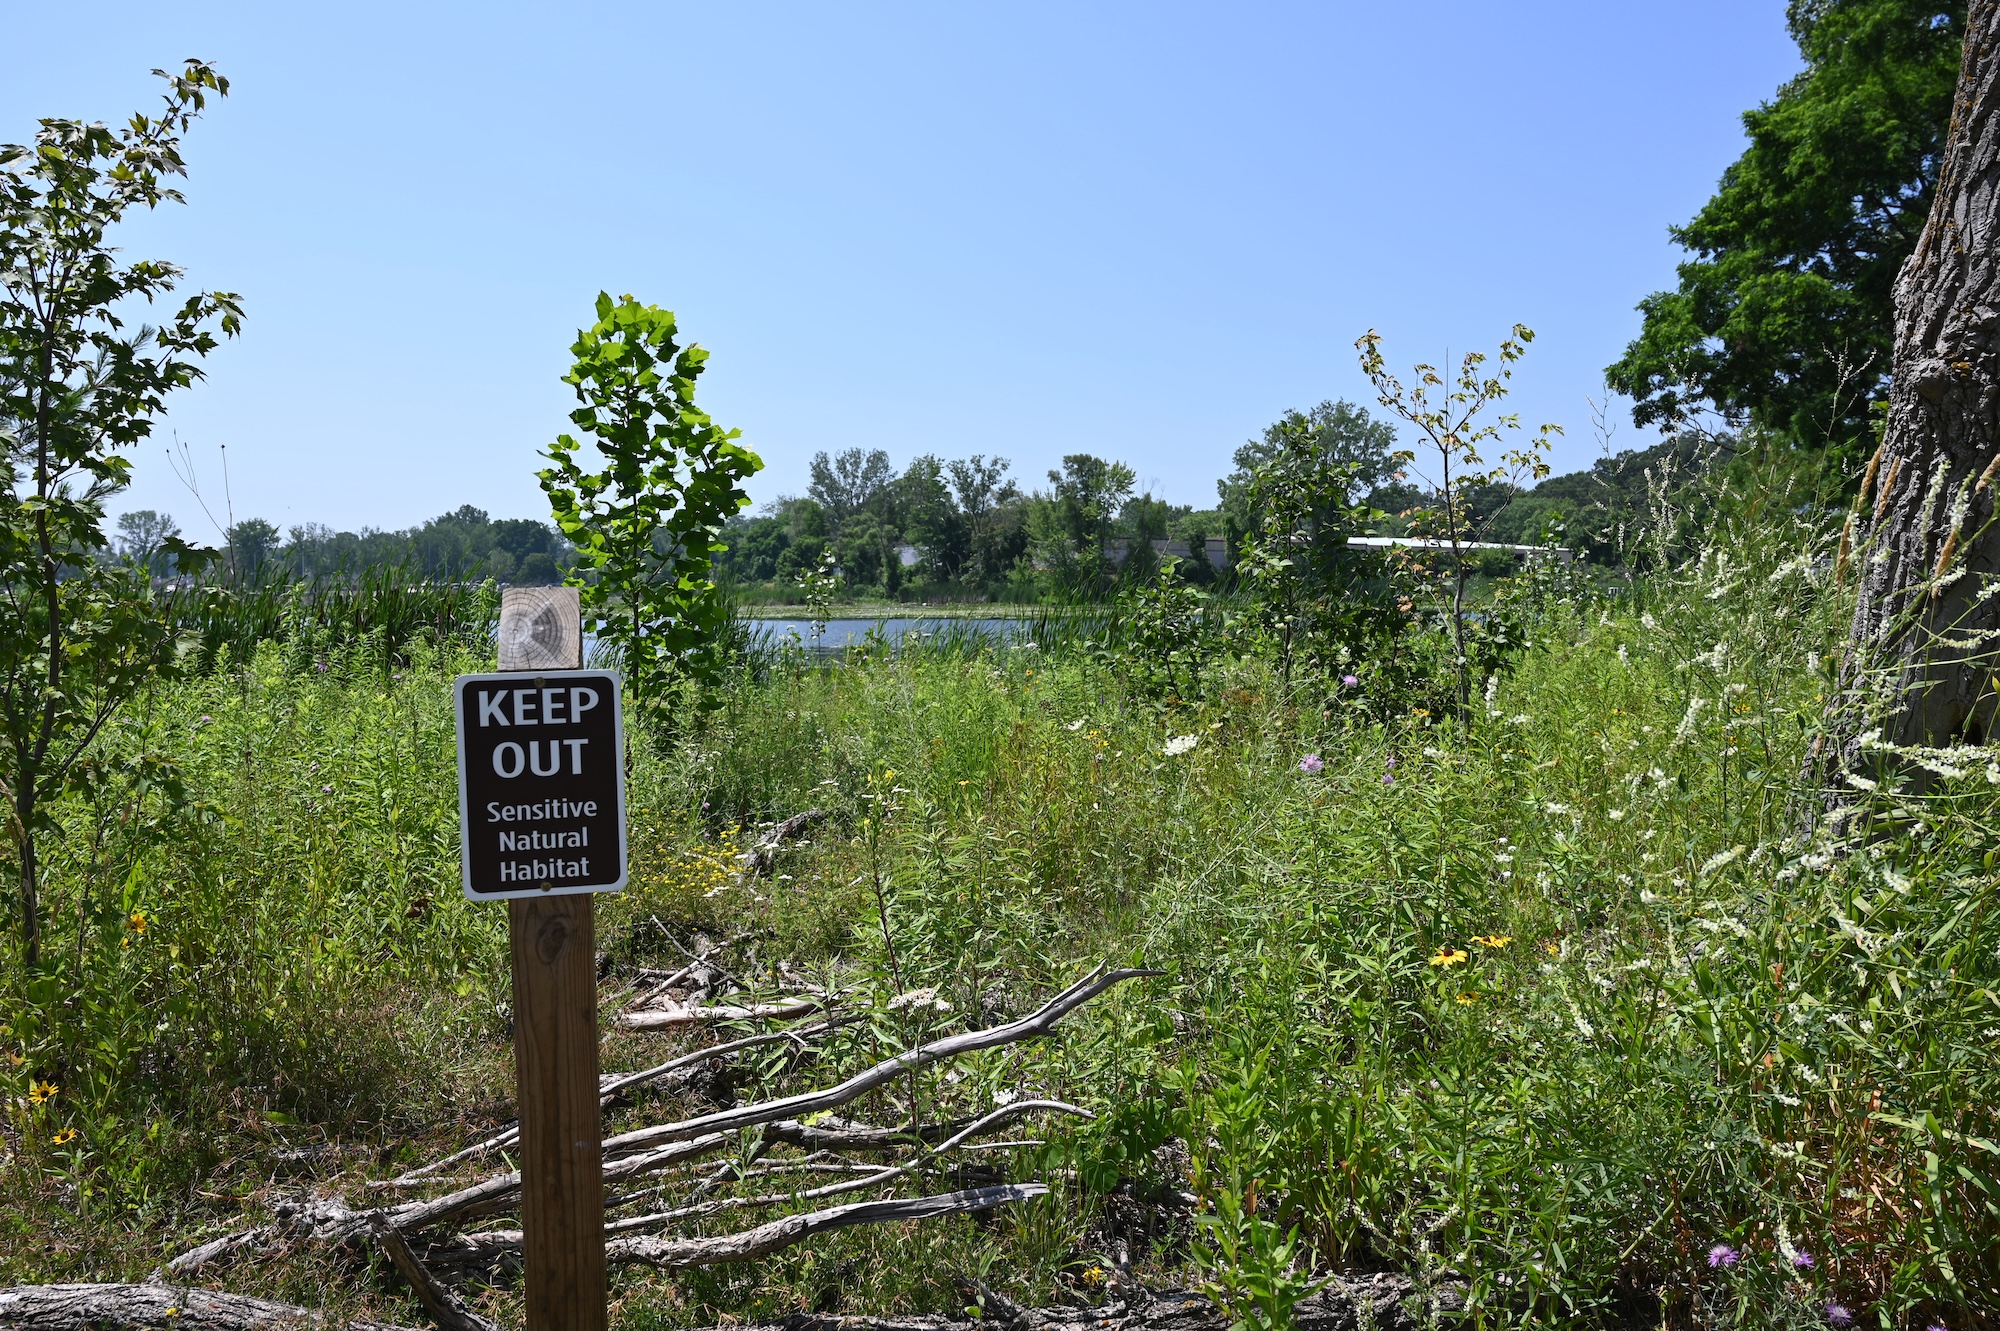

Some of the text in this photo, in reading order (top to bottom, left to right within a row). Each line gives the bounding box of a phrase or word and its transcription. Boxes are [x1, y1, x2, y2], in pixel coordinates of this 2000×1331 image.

[478, 687, 599, 727] KEEP
[492, 738, 589, 779] OUT
[486, 798, 597, 823] Sensitive
[499, 826, 588, 852] Natural
[500, 857, 590, 882] Habitat
